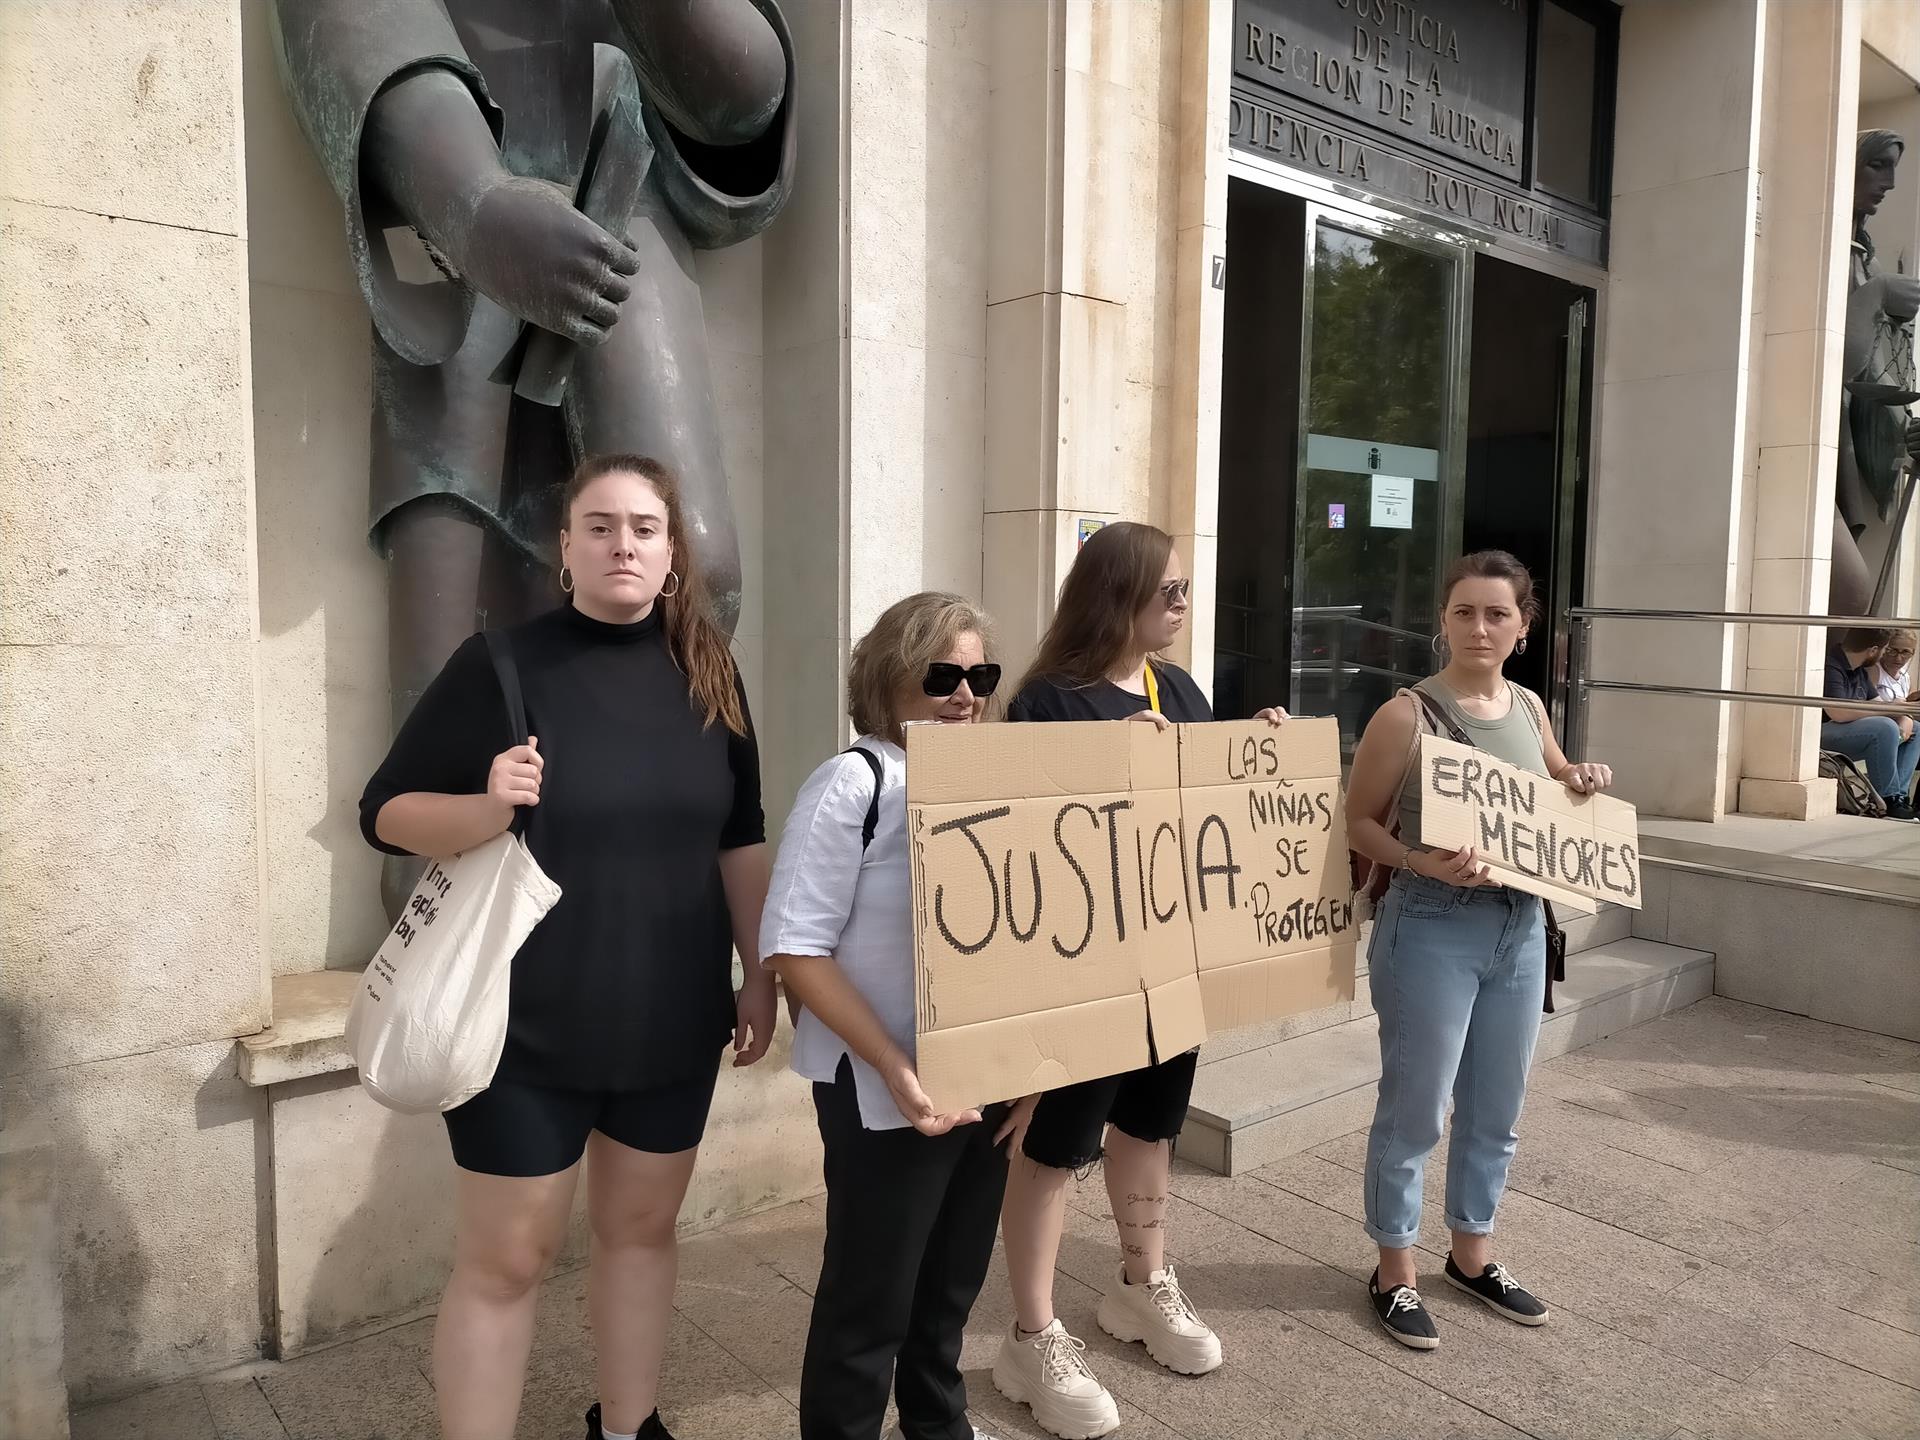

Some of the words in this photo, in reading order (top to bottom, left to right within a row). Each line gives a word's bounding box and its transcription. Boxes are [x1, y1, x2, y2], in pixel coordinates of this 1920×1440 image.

[1338, 0, 1460, 63] USTICIA
[1353, 24, 1392, 73] DE
[1405, 49, 1442, 97] LA
[1246, 22, 1363, 104] REGION
[1378, 79, 1415, 126] DE
[1429, 100, 1516, 167] MURCIA
[1214, 256, 1225, 286] 7
[1228, 736, 1278, 780] LAS
[1432, 756, 1535, 816] ERAN
[1249, 778, 1332, 833] NIÑAS
[1276, 837, 1310, 878] SE
[1479, 811, 1637, 898] MENORES
[1251, 881, 1353, 947] PROTEGEN
